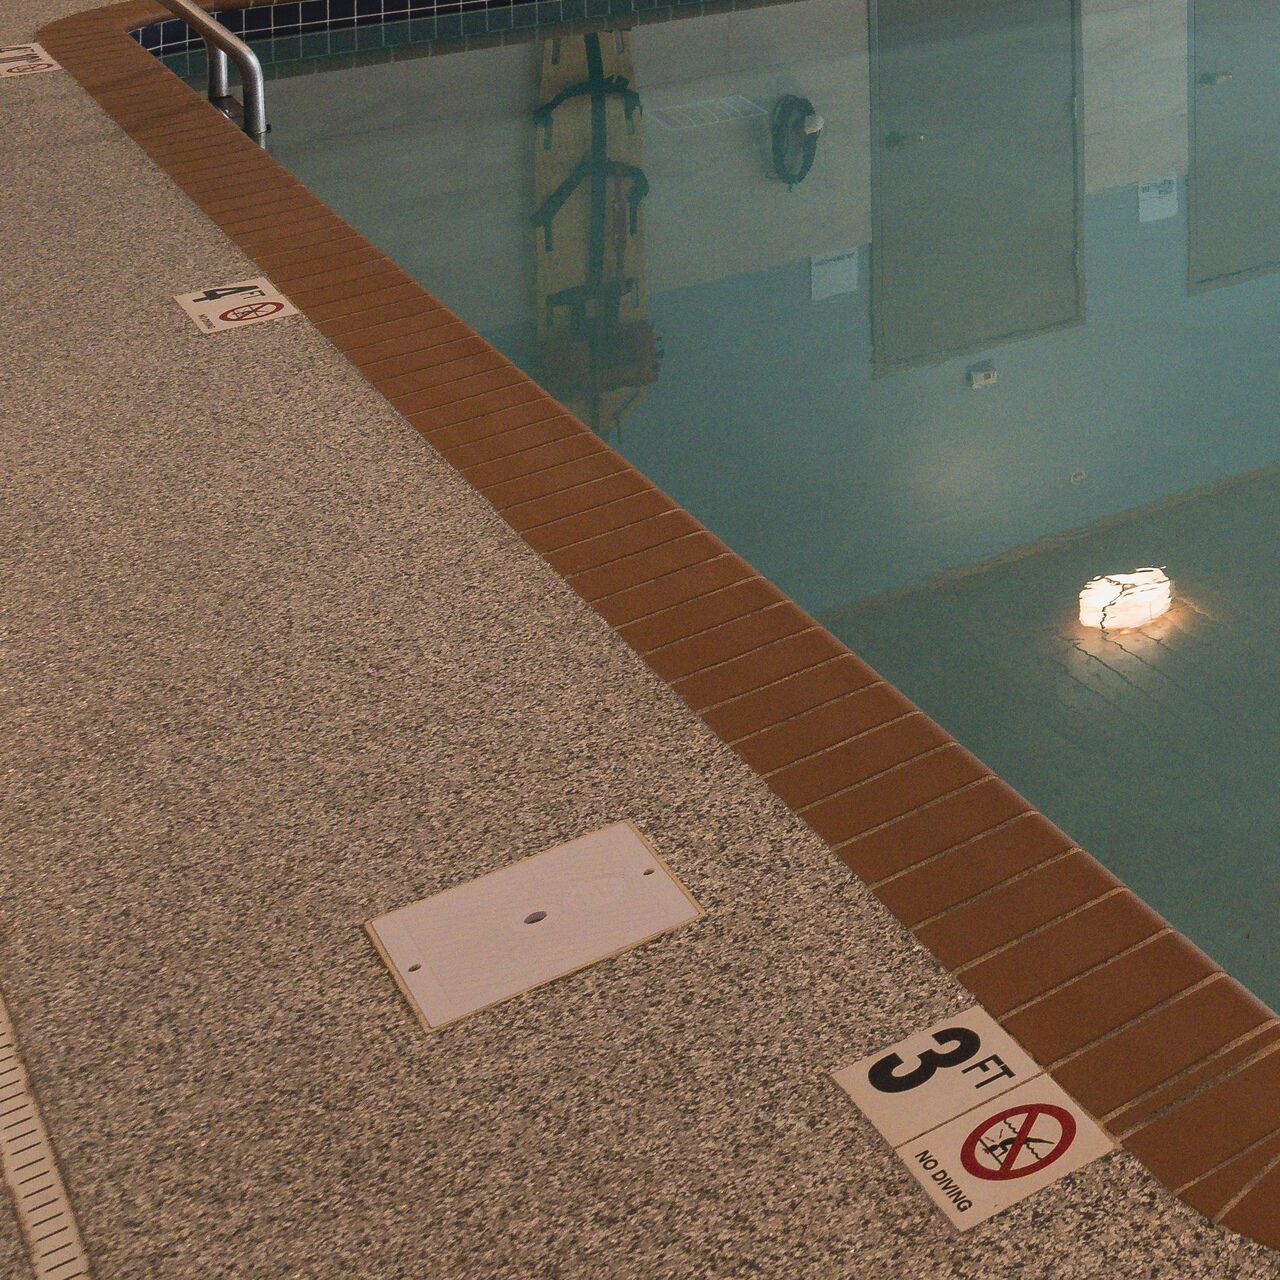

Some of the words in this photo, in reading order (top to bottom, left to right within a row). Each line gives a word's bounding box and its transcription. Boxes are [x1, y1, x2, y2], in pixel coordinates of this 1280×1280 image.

[192, 285, 260, 303] 4
[867, 1026, 982, 1094] 3
[961, 1054, 1017, 1090] FT
[914, 1149, 939, 1170] NO
[931, 1169, 973, 1214] DIVING
